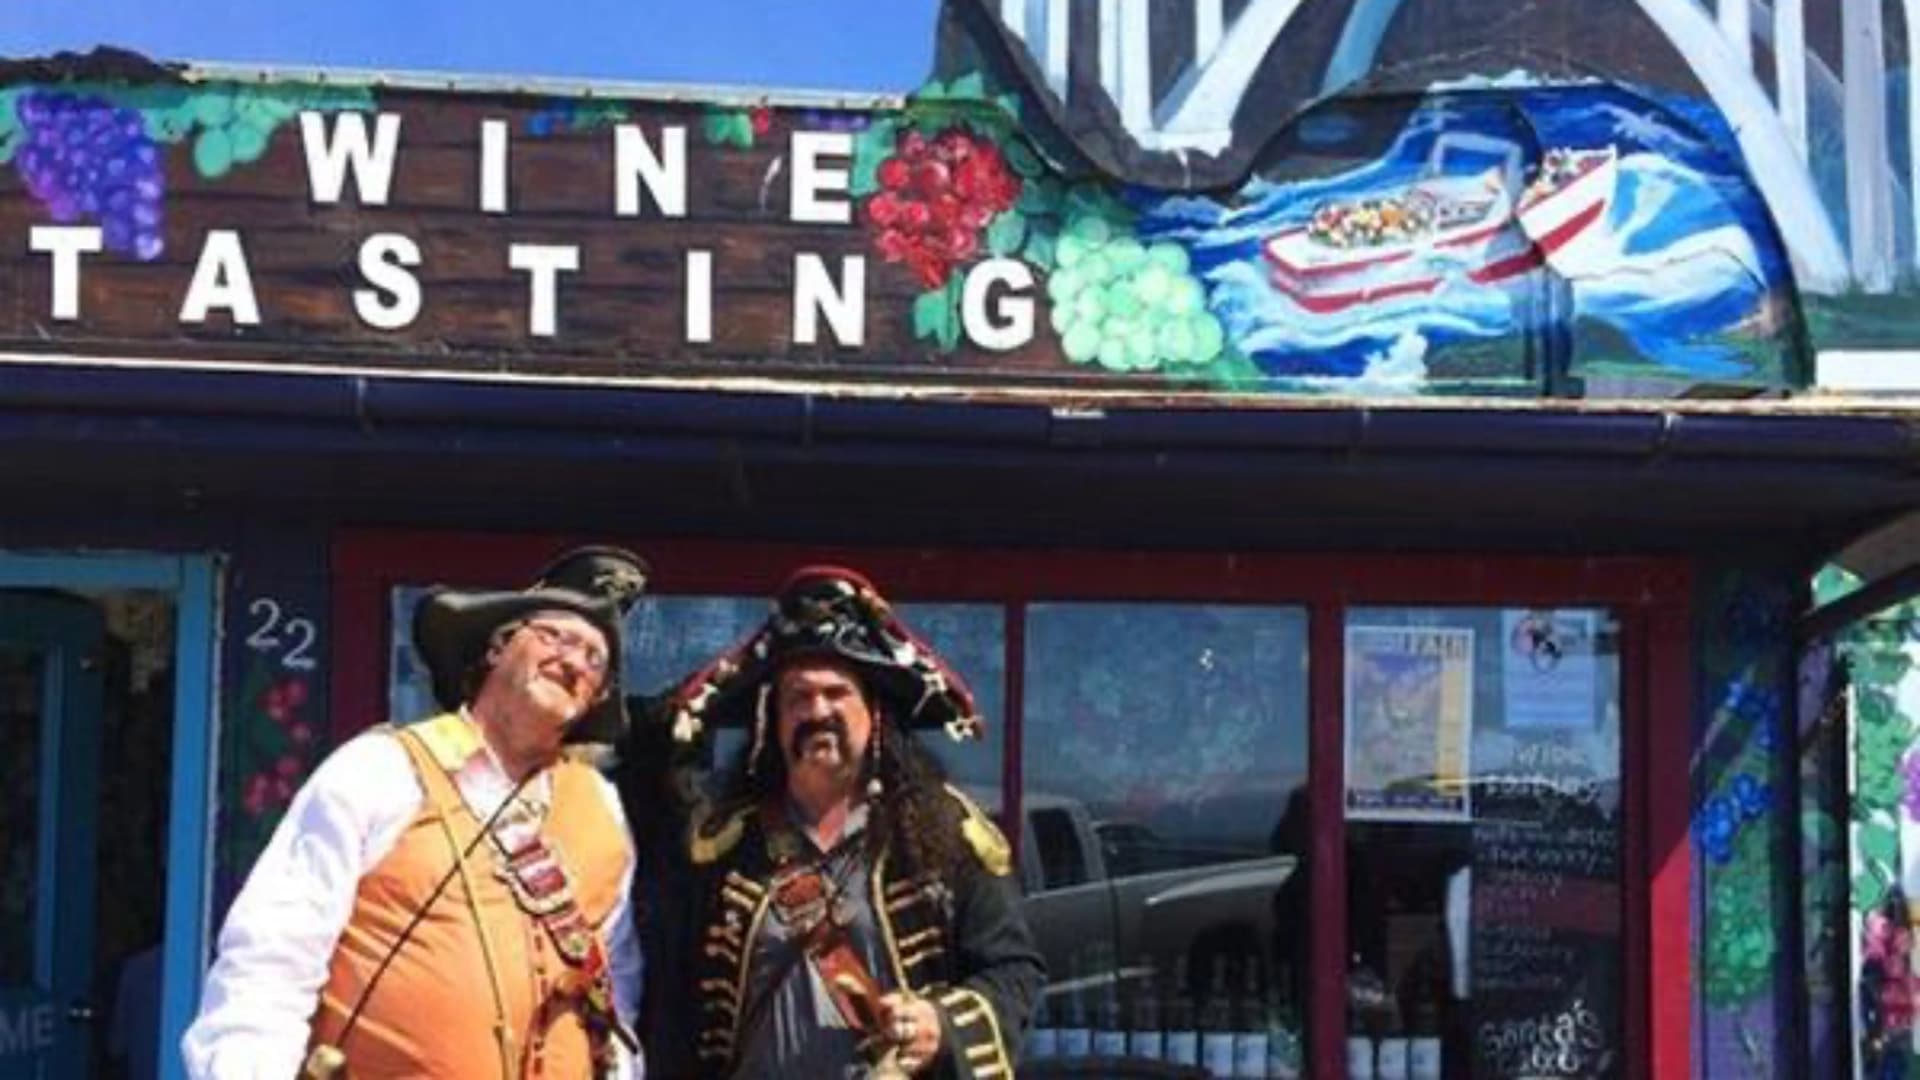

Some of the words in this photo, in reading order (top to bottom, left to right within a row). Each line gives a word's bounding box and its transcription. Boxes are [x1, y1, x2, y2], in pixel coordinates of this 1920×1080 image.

[300, 111, 852, 224] WINE
[30, 226, 1035, 351] TASTING
[246, 598, 317, 669] 22
